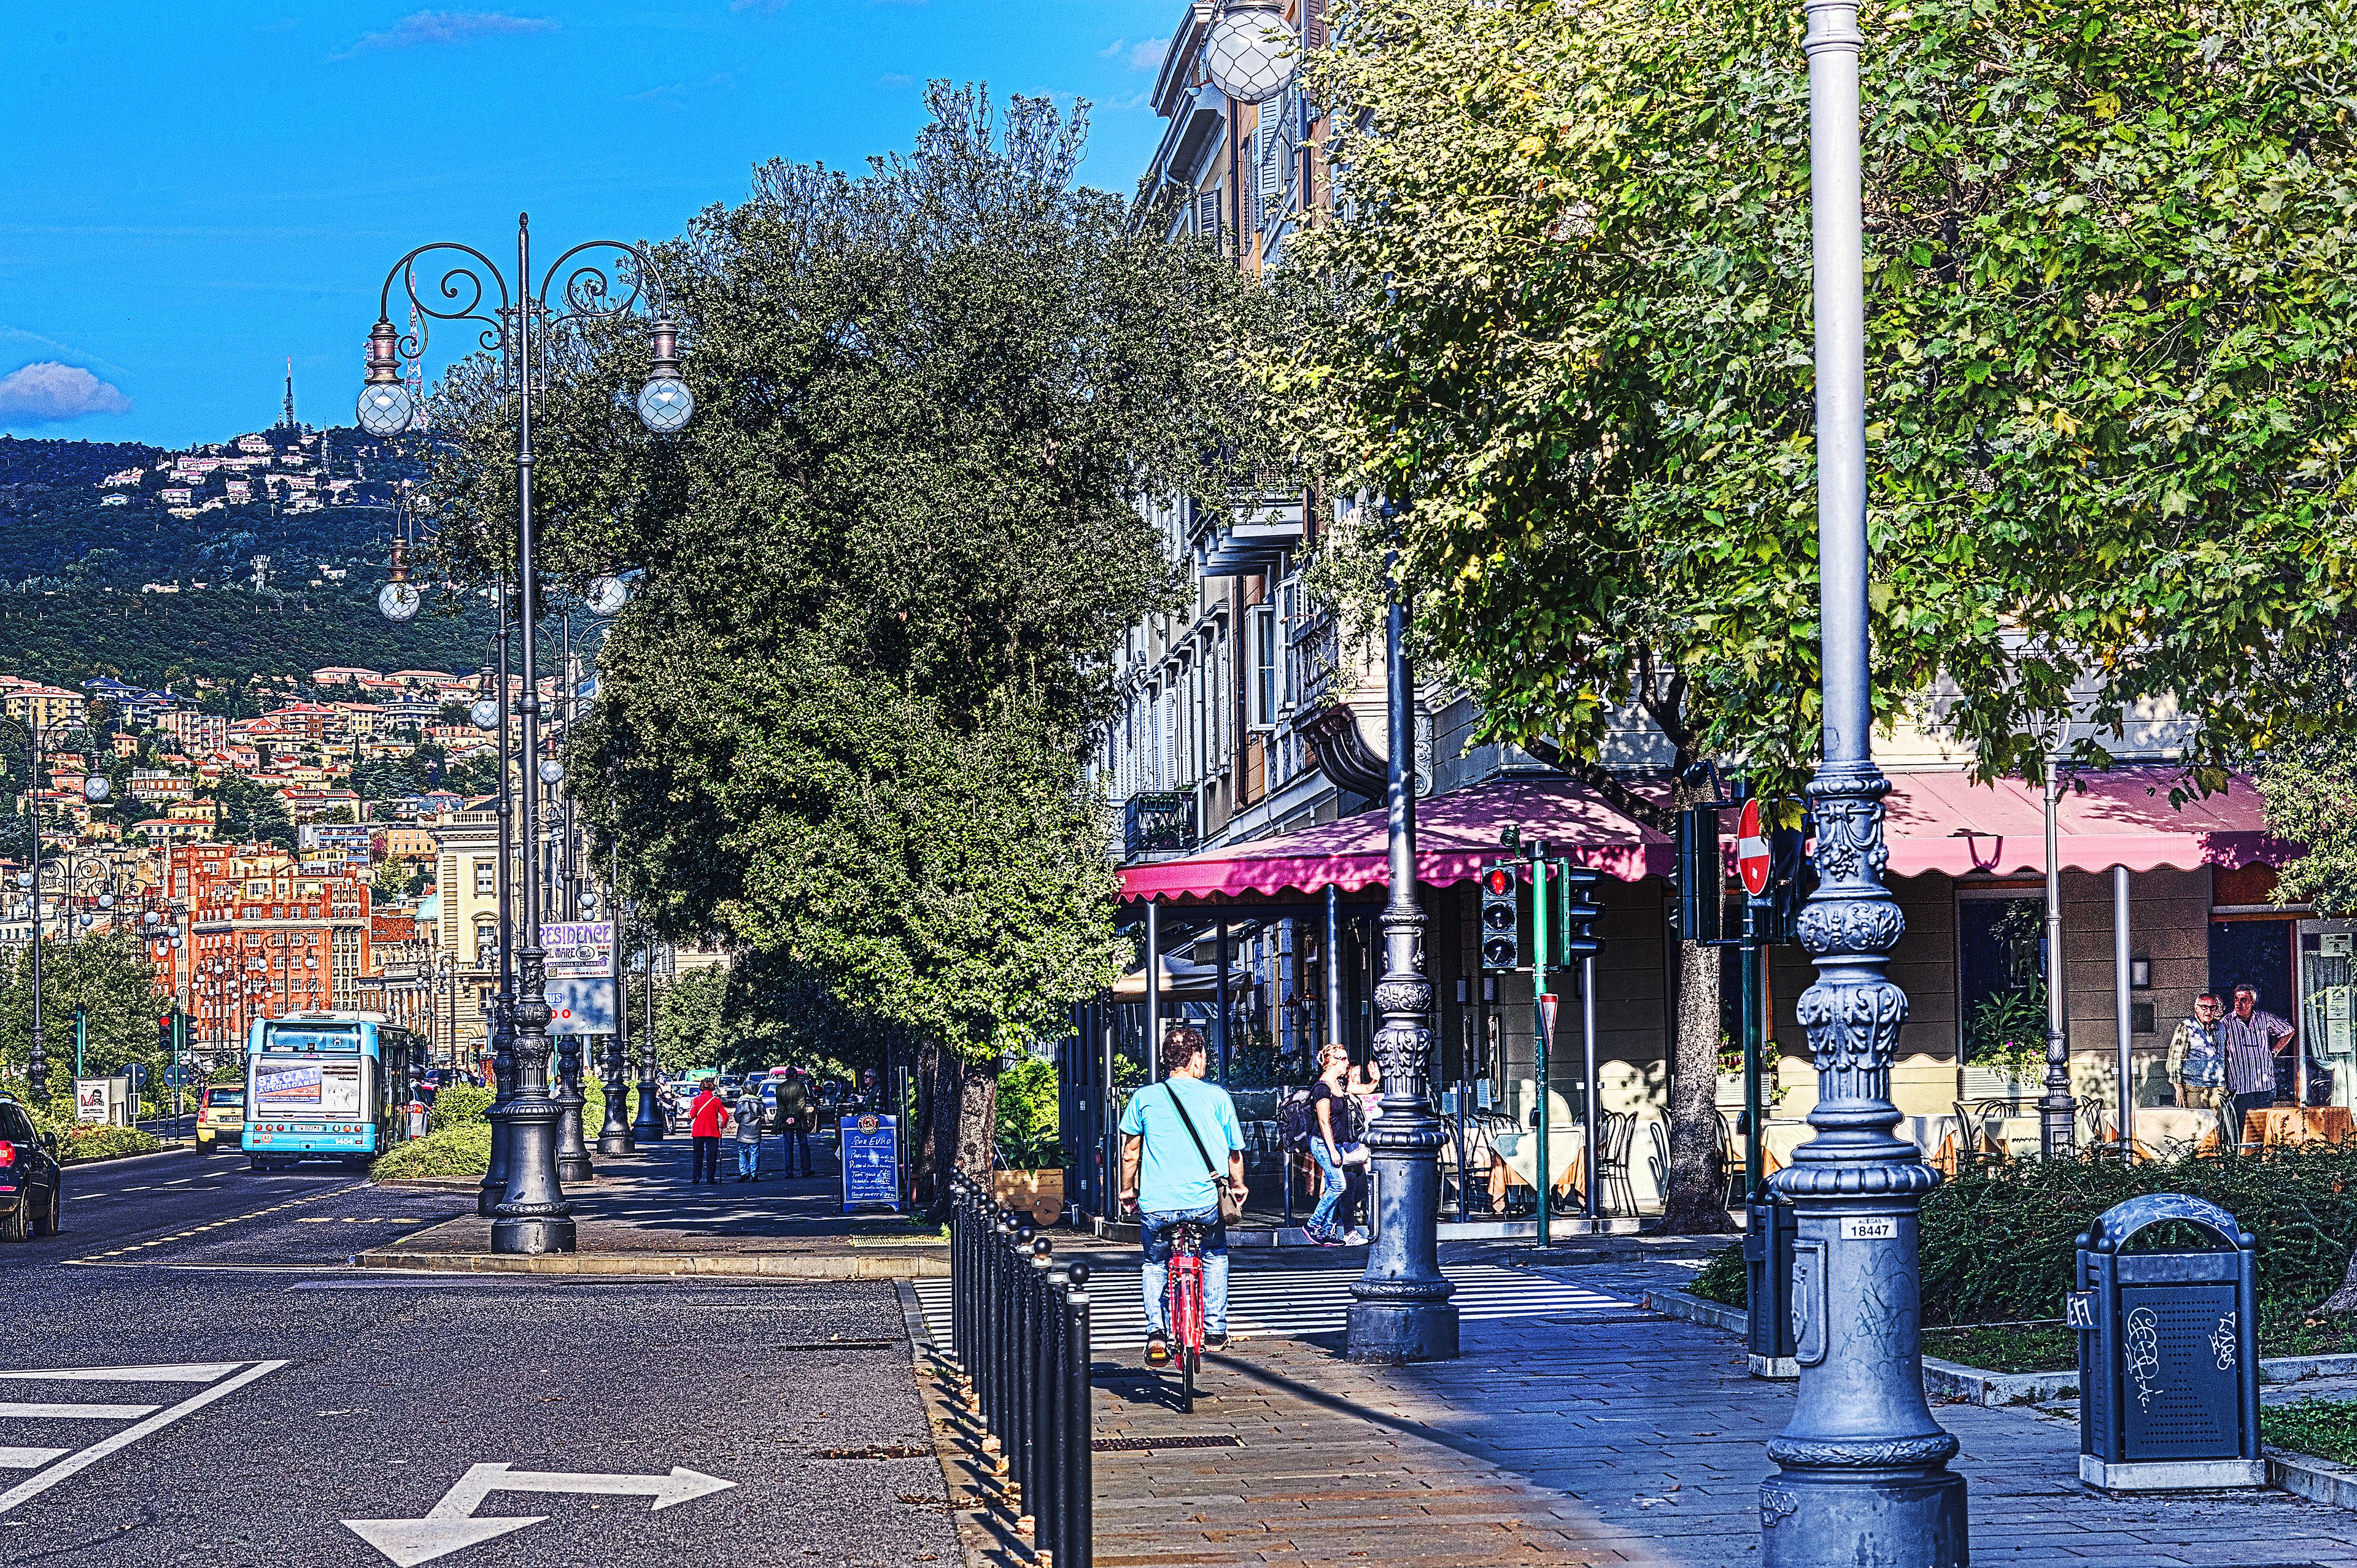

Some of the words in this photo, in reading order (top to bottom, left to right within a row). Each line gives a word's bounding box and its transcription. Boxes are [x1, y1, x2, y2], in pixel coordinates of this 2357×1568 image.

[540, 925, 611, 946] RESIDENCE
[555, 948, 575, 959] MARE
[257, 1068, 317, 1087] S.A.C.A.T.
[259, 1078, 319, 1094] AUTORICAMBI
[869, 1137, 891, 1145] EURO
[1851, 1225, 1889, 1236] 18447
